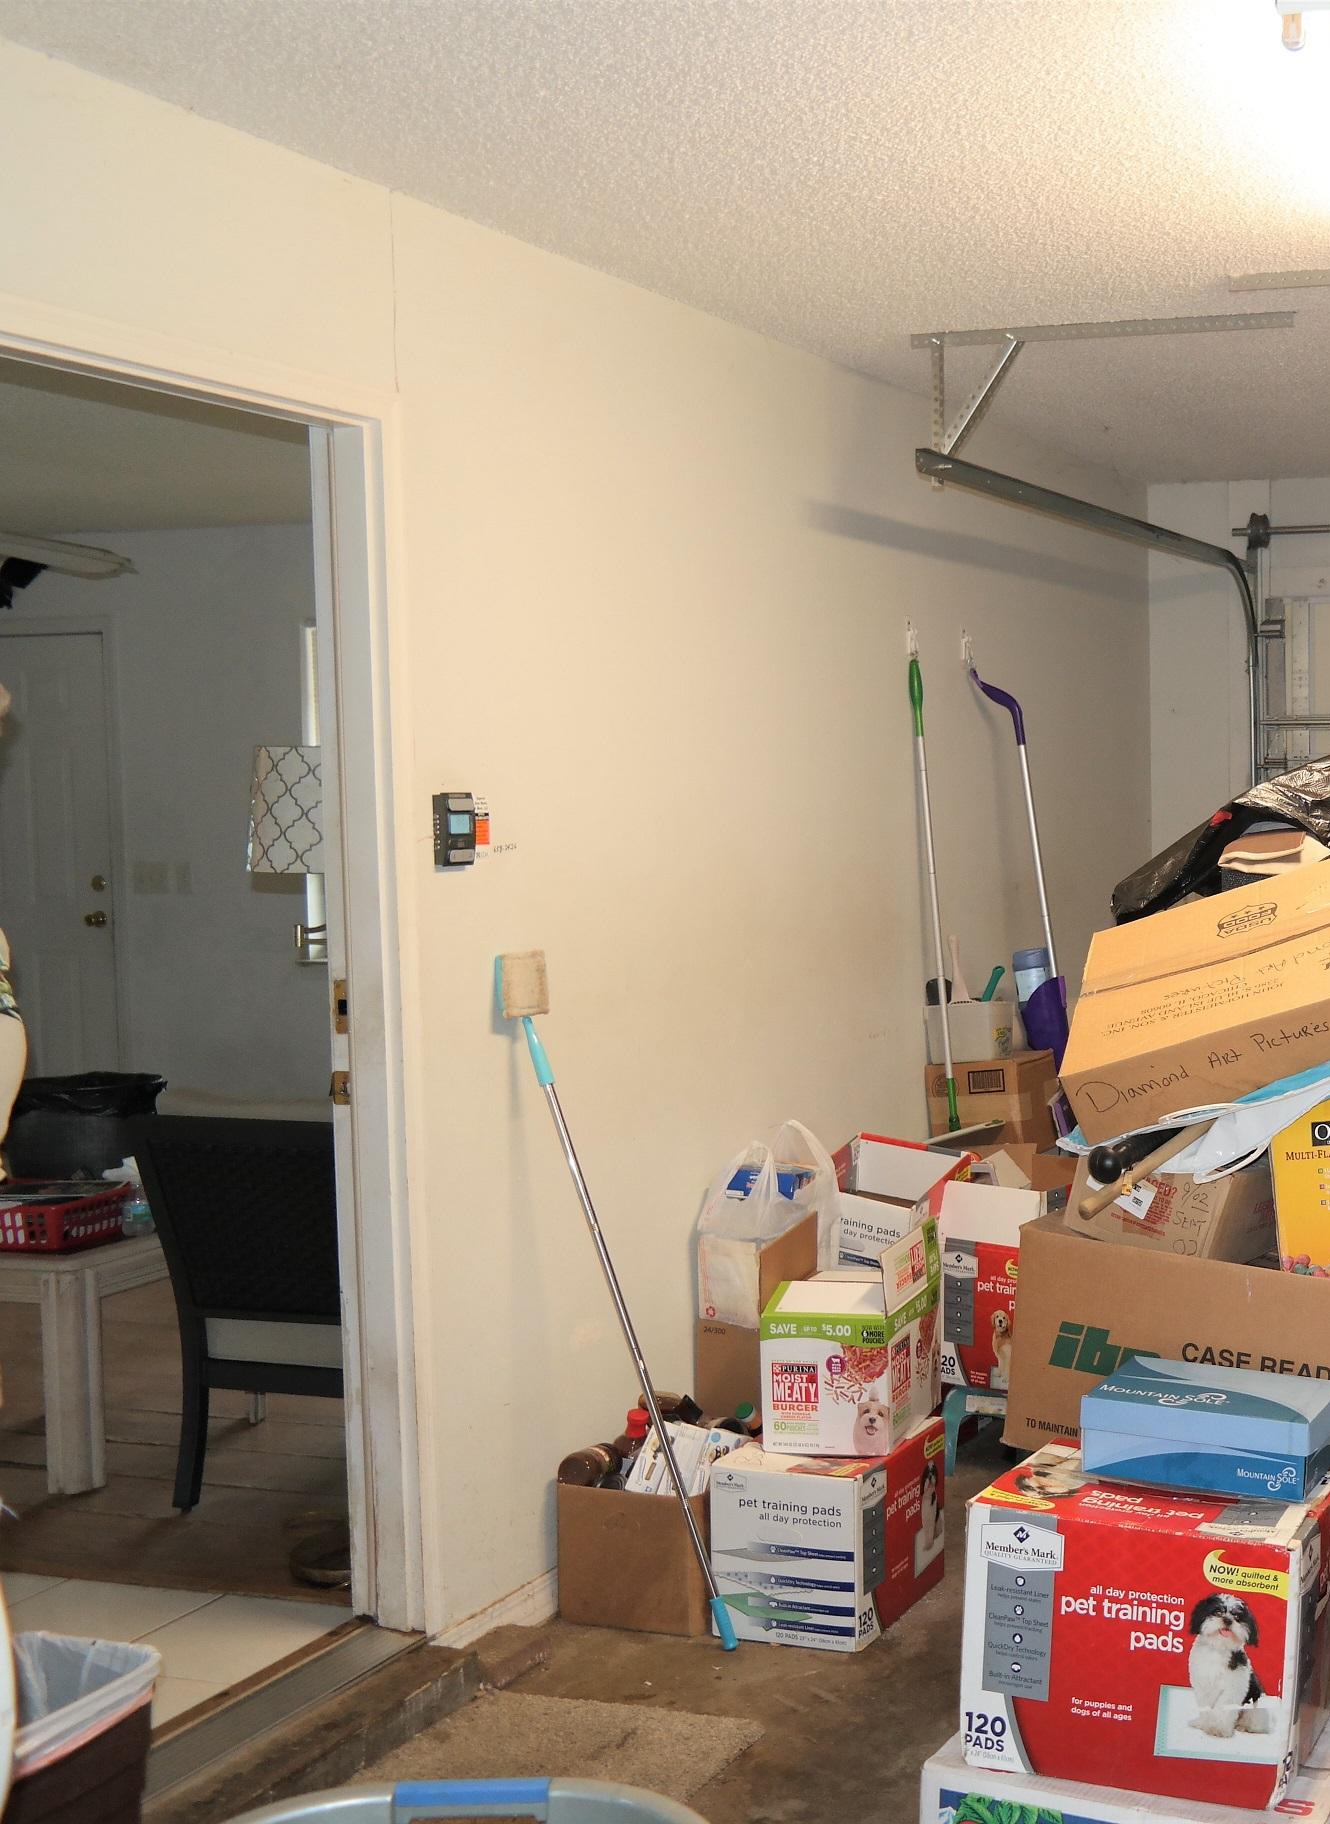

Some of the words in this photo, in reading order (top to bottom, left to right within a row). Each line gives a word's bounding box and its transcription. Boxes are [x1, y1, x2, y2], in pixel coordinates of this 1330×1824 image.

[1076, 1065, 1190, 1113] Diamond
[841, 1217, 873, 1232] raining
[877, 1227, 901, 1238] pads
[843, 1228, 857, 1238] day
[860, 1233, 895, 1246] protectio
[977, 1281, 993, 1293] pet
[769, 1323, 797, 1335] SAVE
[822, 1324, 851, 1336] $5.00
[941, 1355, 956, 1368] 20
[1182, 1342, 1251, 1369] CASE
[781, 1365, 816, 1373] PURINA
[941, 1367, 956, 1376] ADS
[773, 1374, 808, 1383] MOIST
[773, 1382, 817, 1401] MEATY
[1099, 1383, 1182, 1401] MOUNTAIN
[773, 1403, 818, 1412] BURGER
[774, 1422, 786, 1431] 60
[1026, 1417, 1037, 1428] TO
[1039, 1419, 1079, 1436] MAINTAIN
[1236, 1468, 1276, 1482] MOUNTAIN
[1090, 1490, 1143, 1504] pads
[739, 1498, 758, 1508] pet
[762, 1500, 807, 1515] training
[812, 1506, 842, 1517] pads
[886, 1502, 897, 1520] pet
[905, 1500, 920, 1522] pads
[1082, 1497, 1160, 1516] training
[759, 1512, 770, 1520] all
[772, 1514, 789, 1524] day
[792, 1516, 842, 1528] protection
[986, 1541, 1029, 1556] Member's
[1031, 1548, 1056, 1559] Mark
[1209, 1564, 1240, 1577] NOW!
[1241, 1571, 1271, 1581] quilted
[1212, 1576, 1234, 1585] more
[1236, 1578, 1279, 1591] absorbent
[1090, 1585, 1103, 1595] all
[1105, 1587, 1126, 1599] day
[1128, 1589, 1184, 1605] protection
[858, 1607, 874, 1626] 120
[1060, 1595, 1096, 1616] pet
[1103, 1598, 1185, 1630] training
[858, 1624, 874, 1638] PADS
[1130, 1629, 1184, 1653] pads
[1071, 1697, 1083, 1705] for
[1084, 1699, 1115, 1711] puppies
[1117, 1703, 1132, 1711] and
[1071, 1706, 1090, 1717] dogs
[1092, 1709, 1101, 1717] of
[1113, 1713, 1132, 1721] ages
[965, 1712, 1006, 1737] 120
[965, 1732, 1005, 1752] PADS
